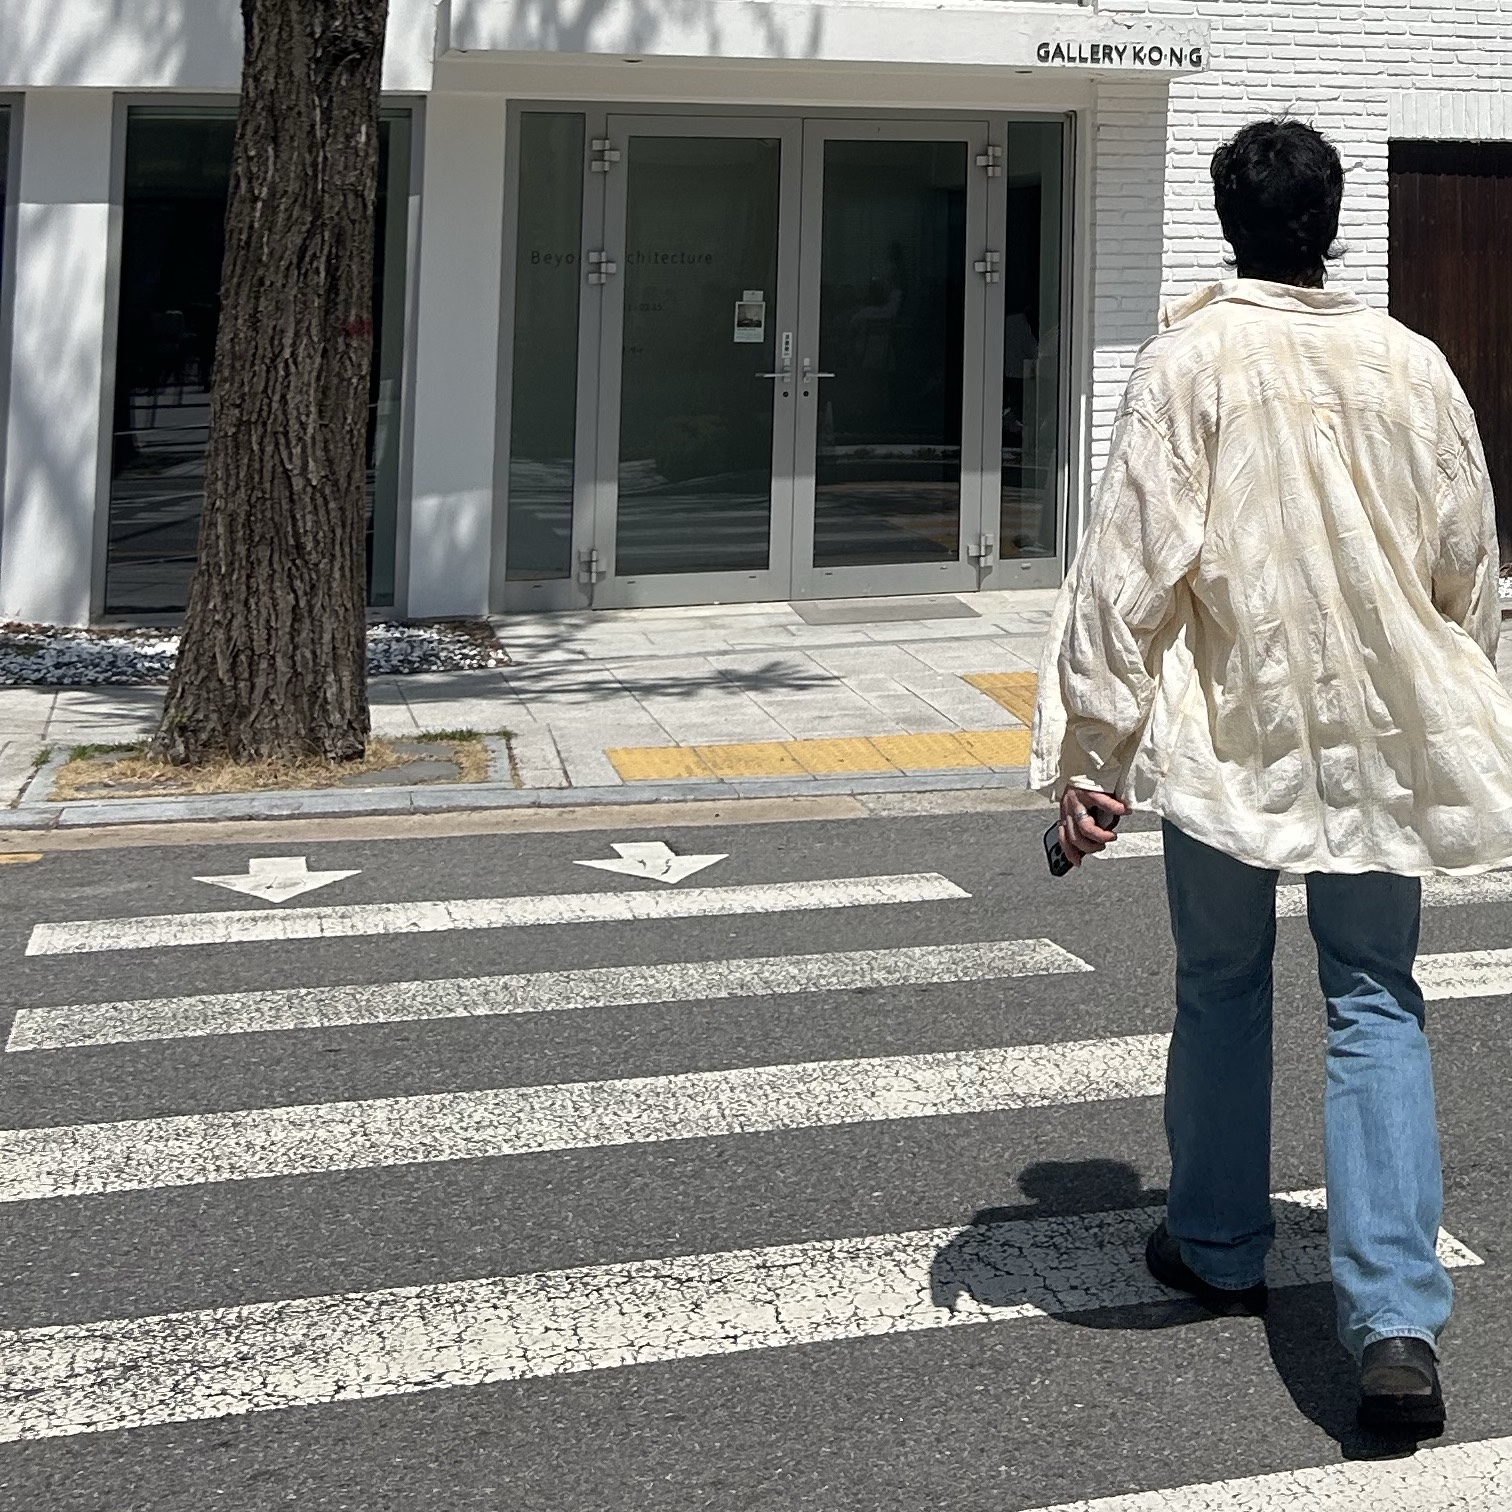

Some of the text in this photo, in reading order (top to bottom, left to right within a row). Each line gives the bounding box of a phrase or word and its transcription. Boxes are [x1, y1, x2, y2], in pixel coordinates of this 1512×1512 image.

[1036, 42, 1128, 65] GALLERY
[530, 249, 713, 269] Beyo chitecture
